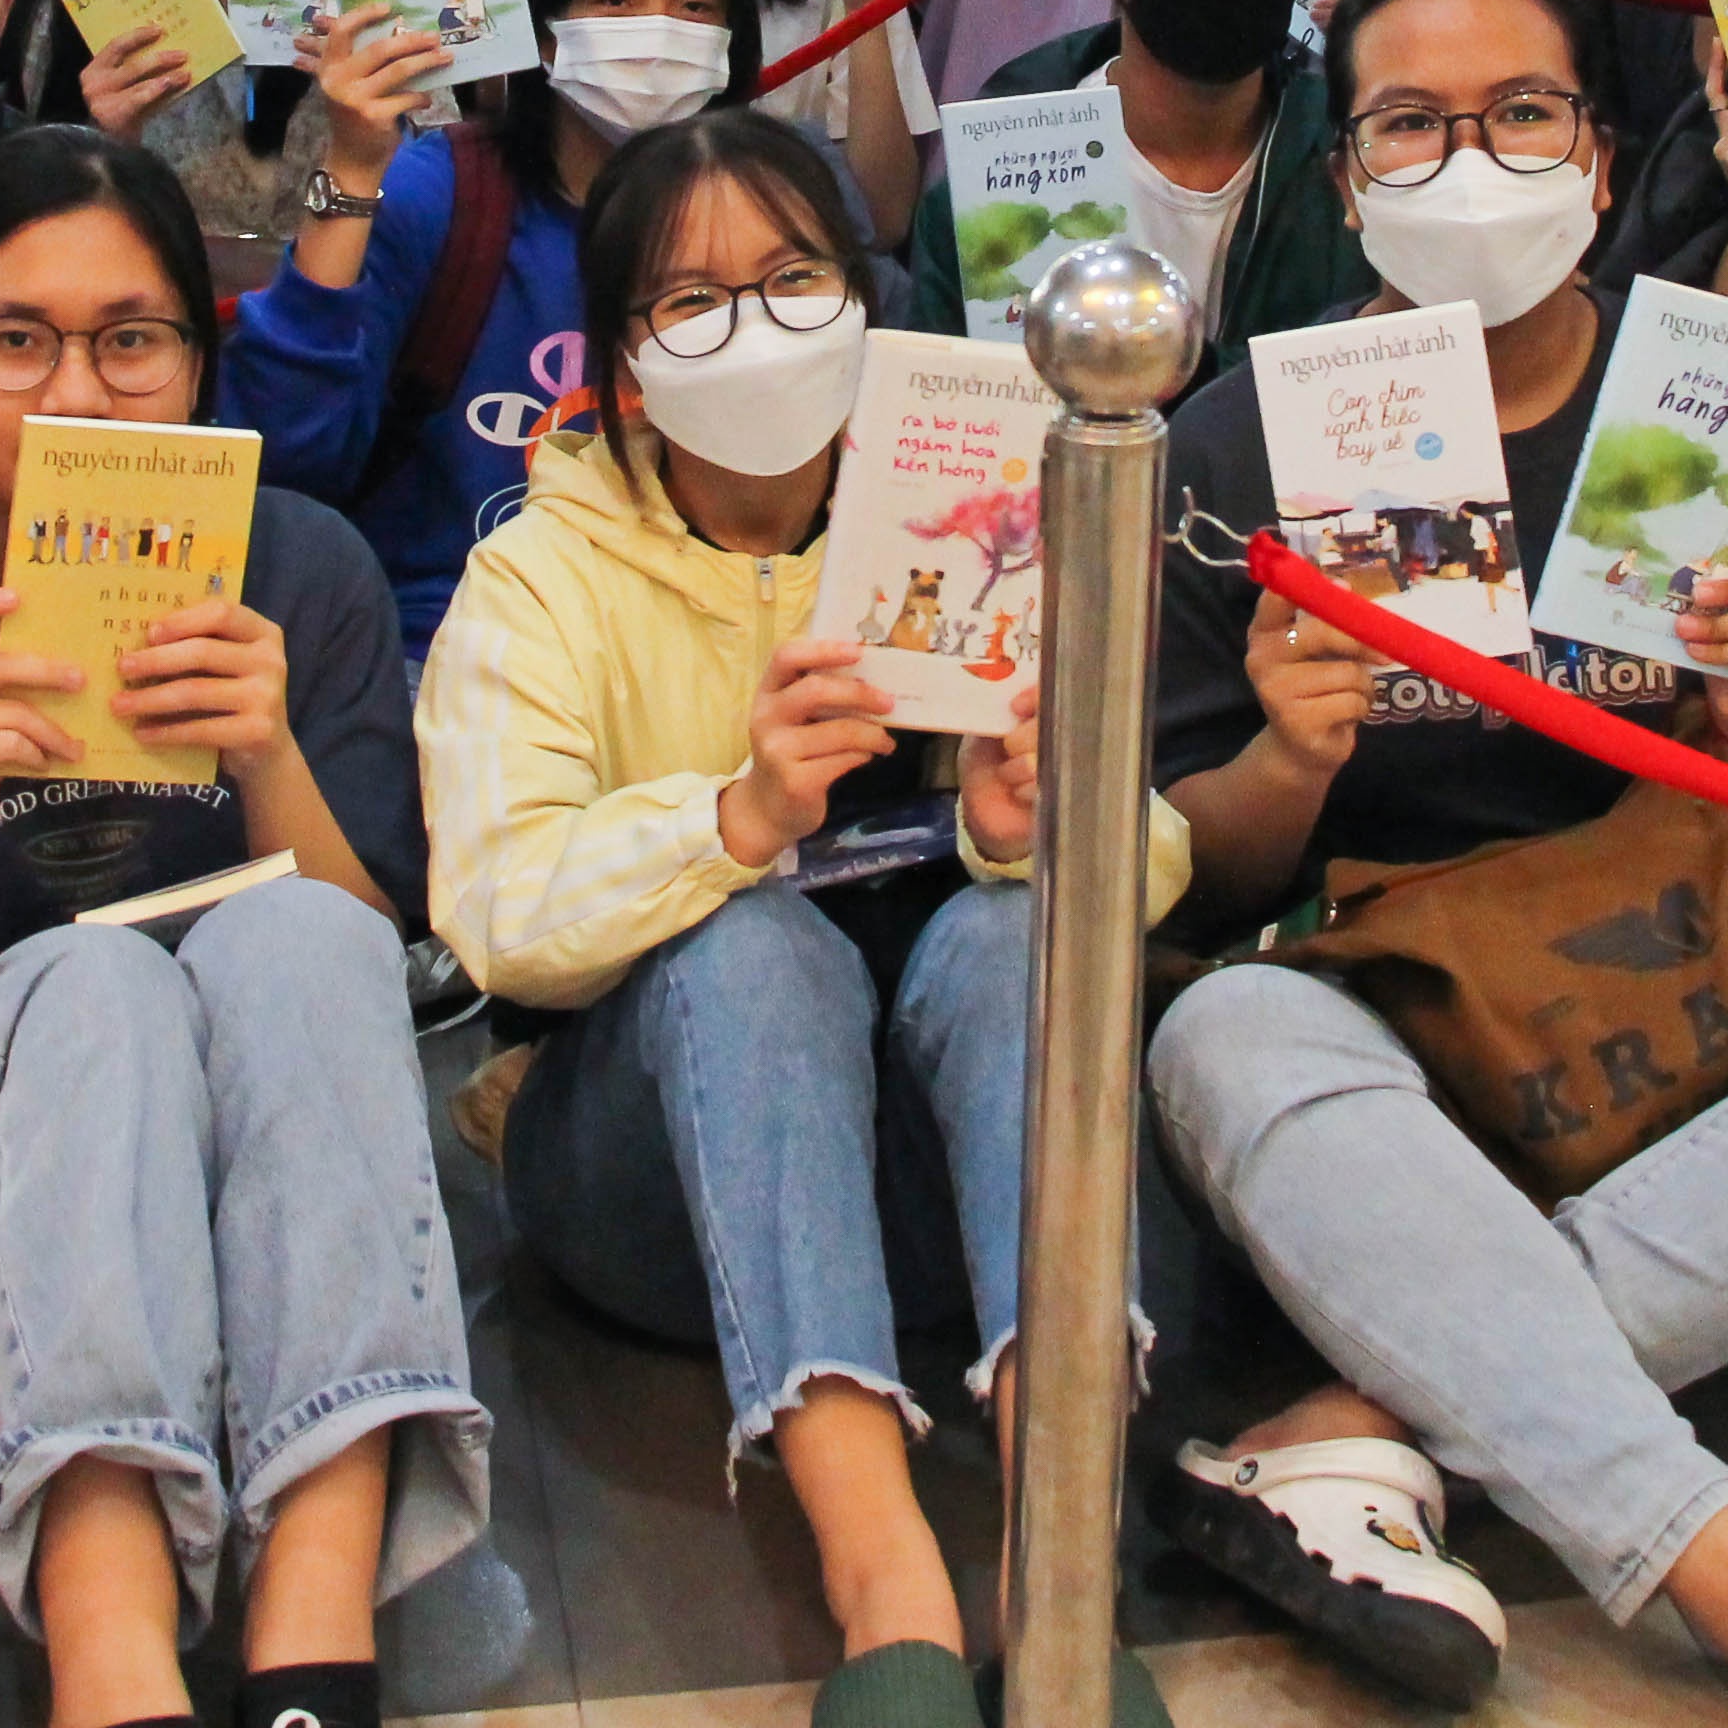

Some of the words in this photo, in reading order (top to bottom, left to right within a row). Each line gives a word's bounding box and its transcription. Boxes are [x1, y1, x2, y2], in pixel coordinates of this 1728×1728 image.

[986, 165, 1042, 194] hàng
[1047, 158, 1086, 183] xóm
[1327, 389, 1370, 416] Con
[1378, 380, 1425, 405] chim
[902, 414, 924, 429] ra
[1323, 414, 1375, 438] xanh
[962, 441, 997, 459] hoa
[1337, 435, 1375, 465] bay
